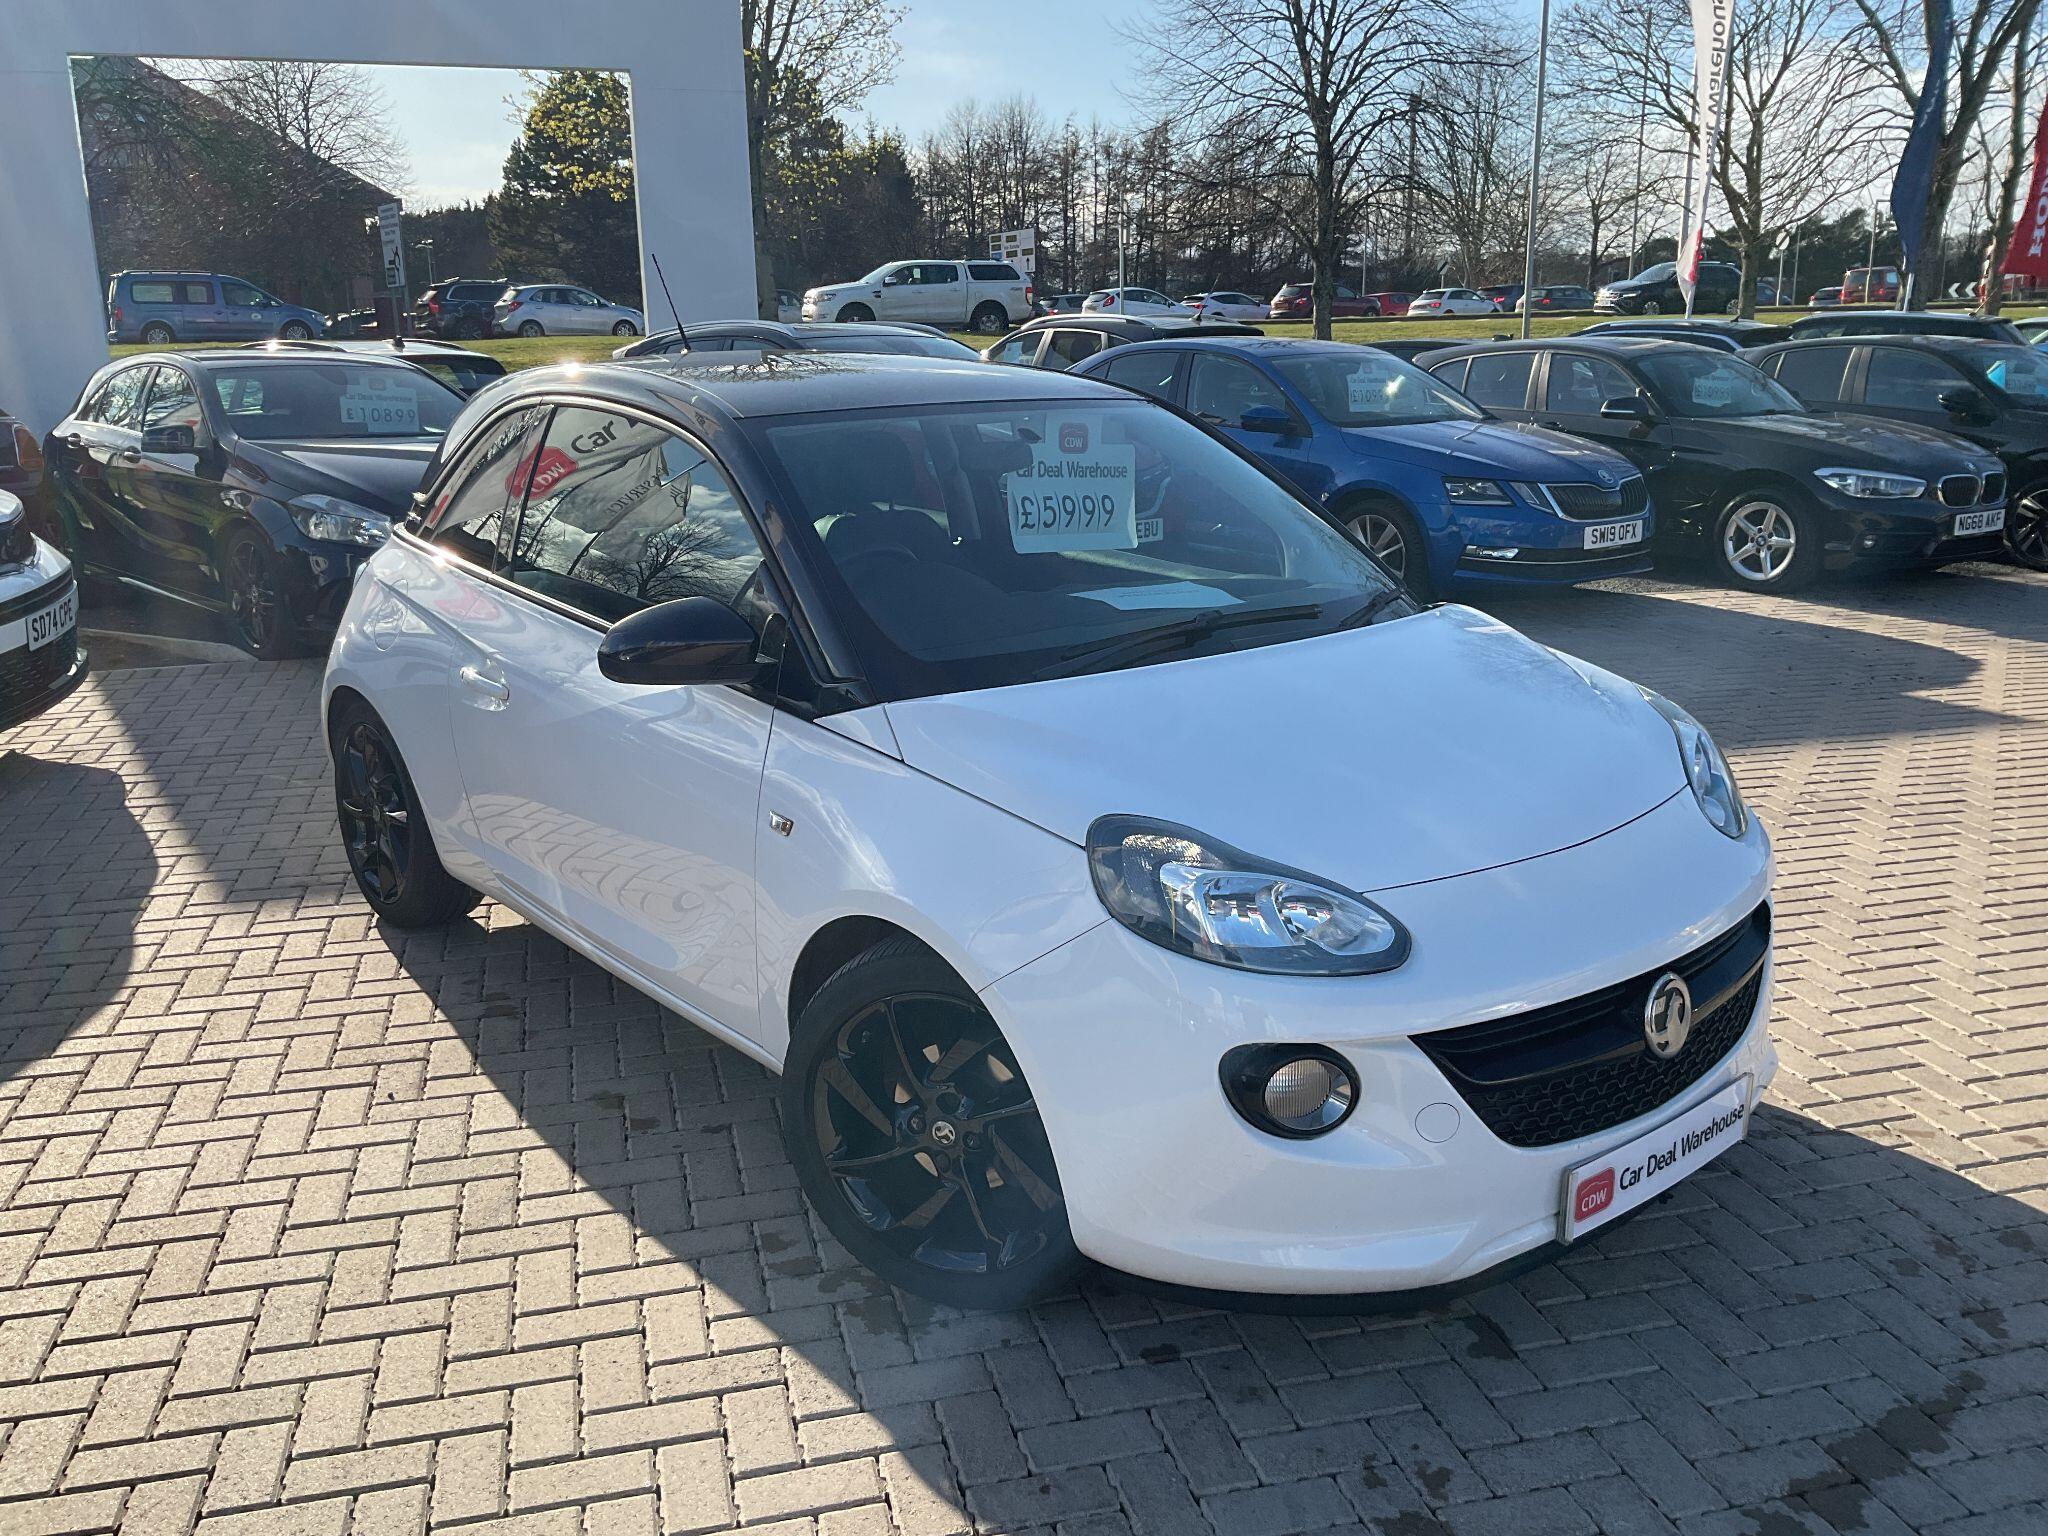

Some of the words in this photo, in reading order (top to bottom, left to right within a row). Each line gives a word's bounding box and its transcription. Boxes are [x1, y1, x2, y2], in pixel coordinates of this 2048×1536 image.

[346, 406, 416, 423] £10899
[570, 420, 618, 454] Car
[1064, 436, 1084, 448] CDW
[1037, 461, 1064, 478] Deal
[1067, 461, 1128, 478] Warehouse
[1020, 494, 1115, 530] £5999
[1591, 525, 1616, 545] SW19
[1618, 522, 1637, 541] OFX
[32, 606, 58, 643] SD74
[1619, 1165, 1644, 1191] Car
[1647, 1141, 1677, 1178] Deal
[1681, 1103, 1745, 1157] Warehouse
[1581, 1187, 1607, 1212] CDW
